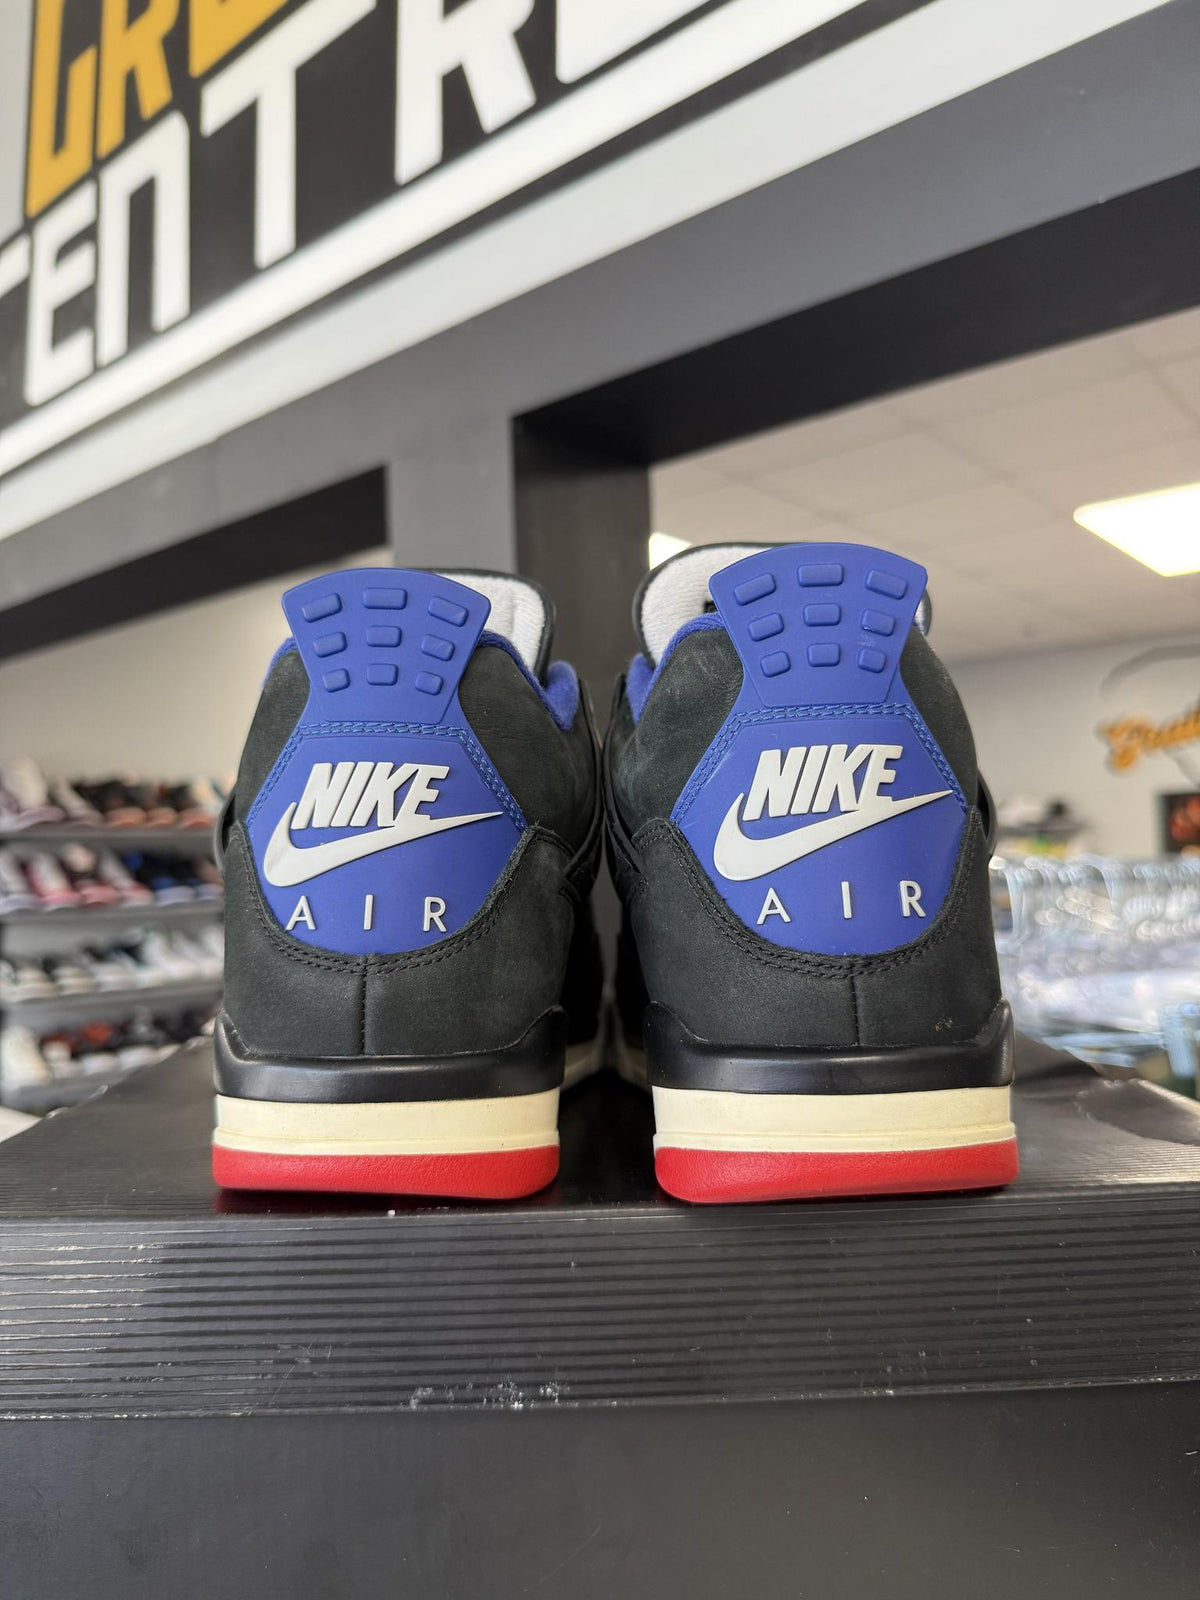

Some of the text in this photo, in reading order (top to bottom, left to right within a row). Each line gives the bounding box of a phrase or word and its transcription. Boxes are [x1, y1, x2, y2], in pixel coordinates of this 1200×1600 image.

[290, 761, 450, 830] NIKE
[742, 743, 903, 822] NIKE
[285, 894, 447, 932] AIR
[756, 880, 926, 925] AIR
